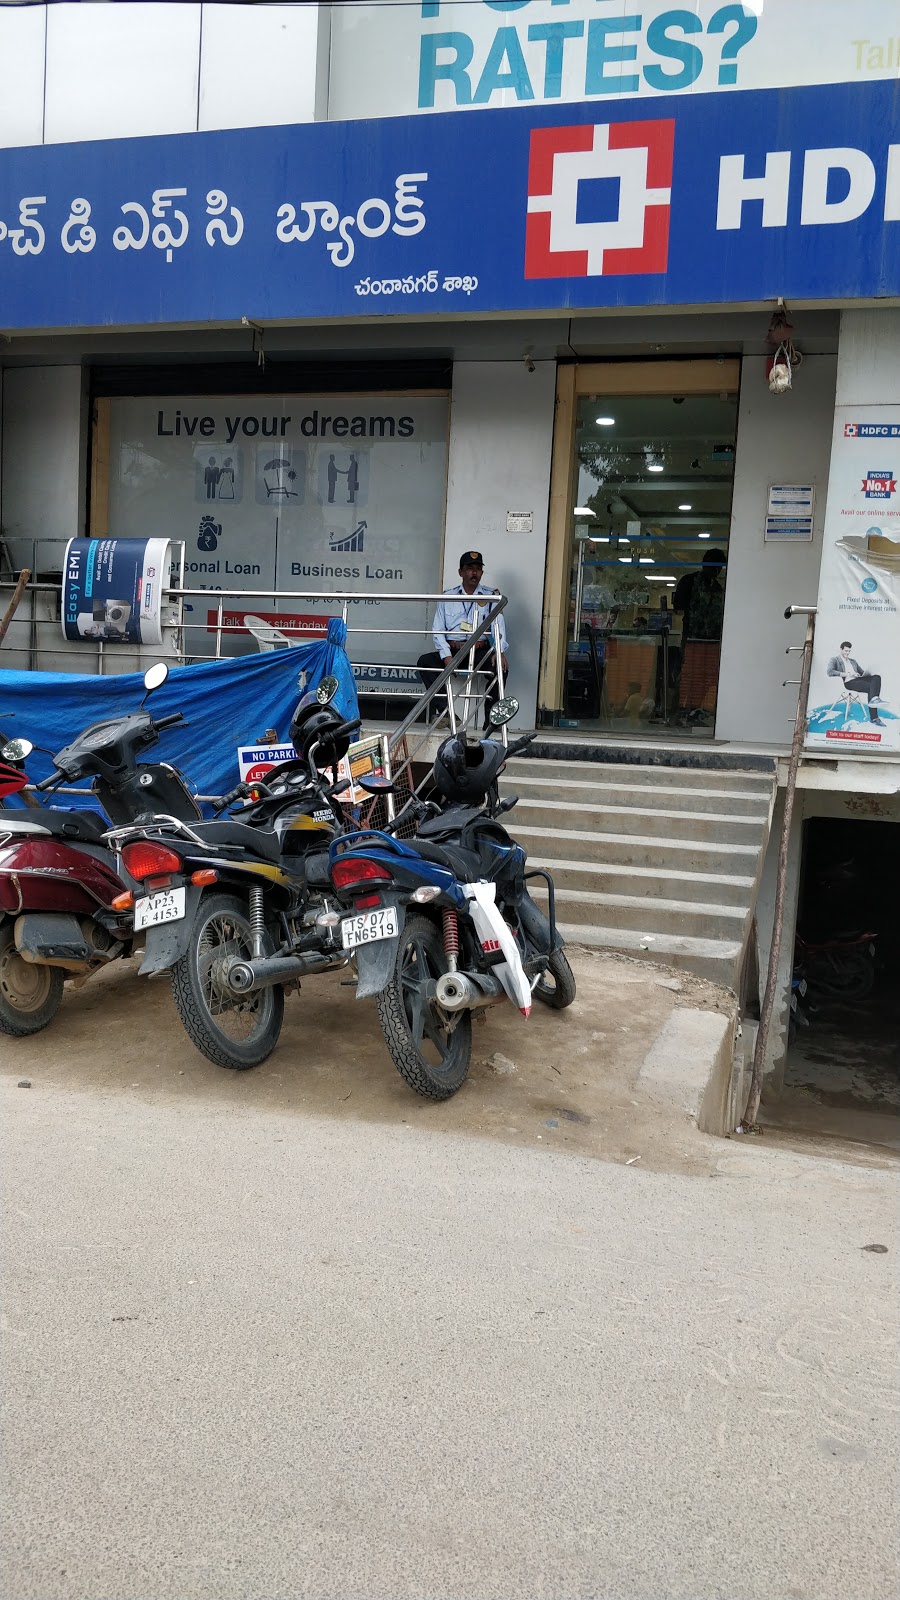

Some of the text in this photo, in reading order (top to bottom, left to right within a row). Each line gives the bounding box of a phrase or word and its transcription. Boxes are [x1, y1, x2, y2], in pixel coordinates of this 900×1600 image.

[418, 4, 758, 109] RATES?
[61, 197, 97, 254] డి
[112, 187, 189, 263] ఎఫ్
[205, 189, 244, 247] సి
[276, 172, 428, 268] బ్యాంక్
[354, 270, 439, 296] చందానగర్
[157, 411, 415, 443] Live your dreams
[861, 427, 888, 435] HDFC
[866, 480, 891, 492] No.1
[170, 560, 220, 573] ersonal
[225, 560, 261, 575] Loan
[291, 562, 403, 580] Business Loan
[222, 616, 240, 626] Talk
[274, 619, 296, 628] staff
[352, 666, 417, 679] DFC BANK
[252, 749, 298, 761] NO PARKI
[312, 814, 335, 823] HONDA
[313, 808, 333, 817] HERO
[145, 895, 174, 912] AP23
[153, 907, 178, 921] 4153
[350, 911, 385, 931] TS 07
[347, 923, 394, 945] FN6519
